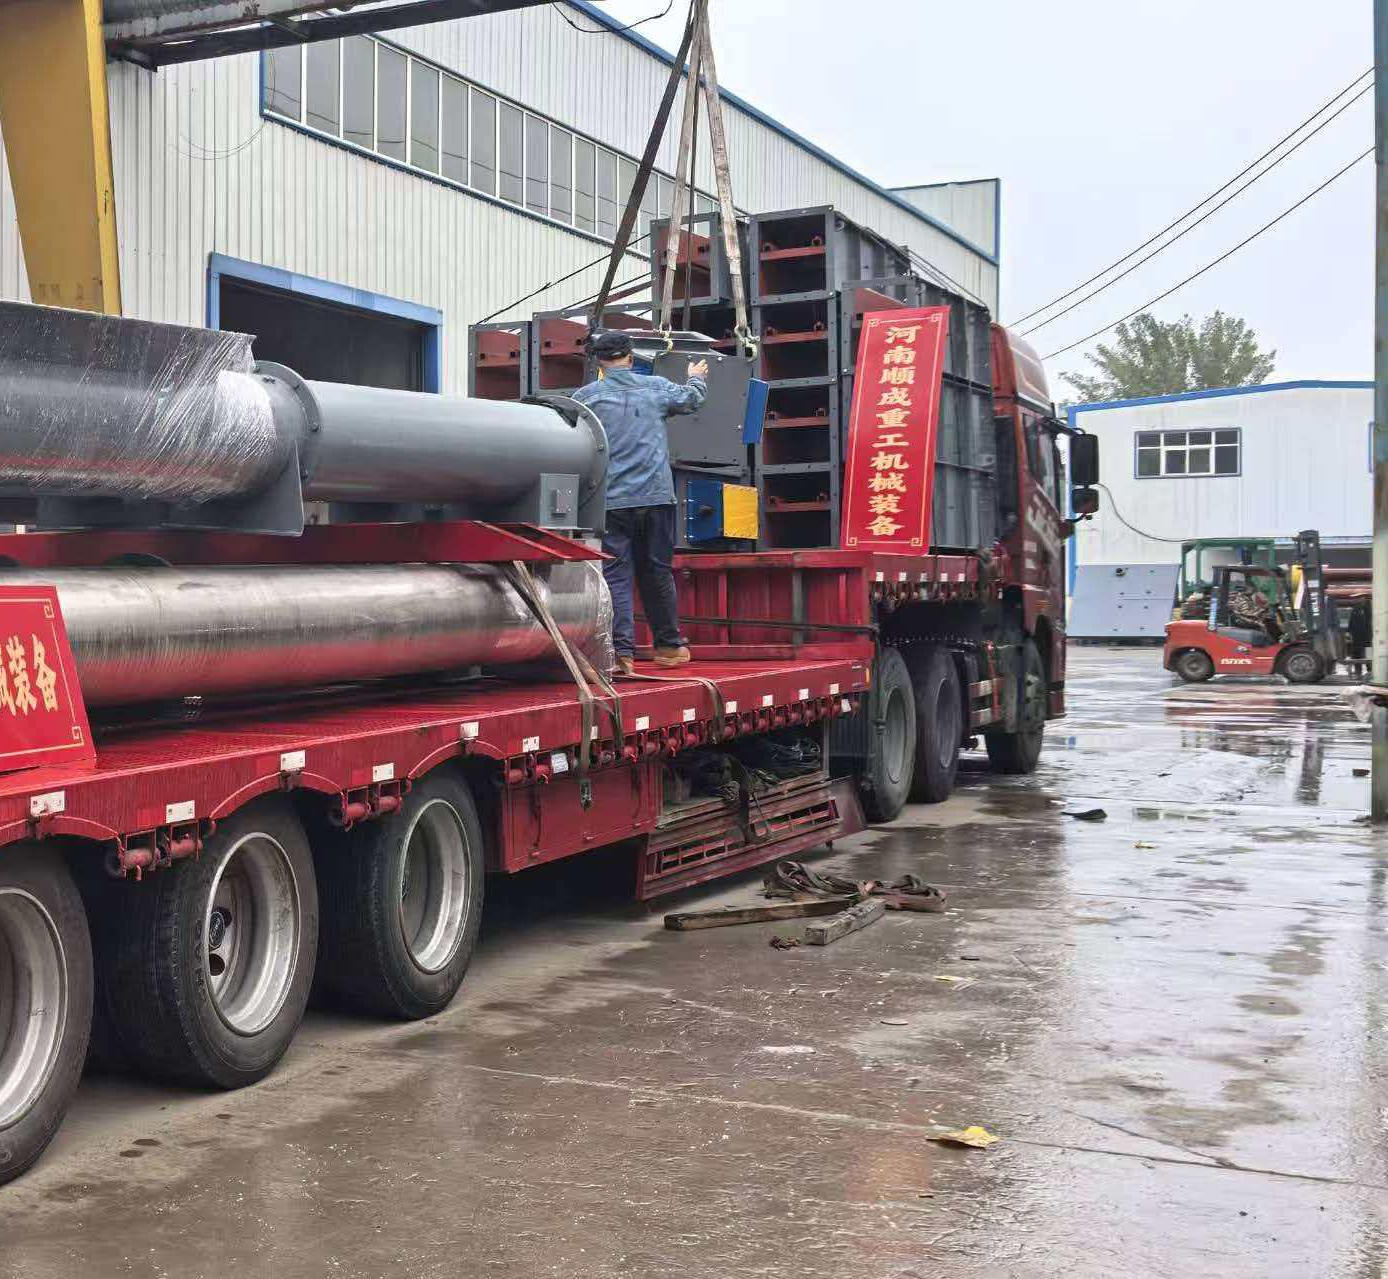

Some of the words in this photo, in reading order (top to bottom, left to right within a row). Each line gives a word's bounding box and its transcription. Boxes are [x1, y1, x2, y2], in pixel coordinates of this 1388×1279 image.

[866, 325, 922, 536] 河南顺成重工机械装备
